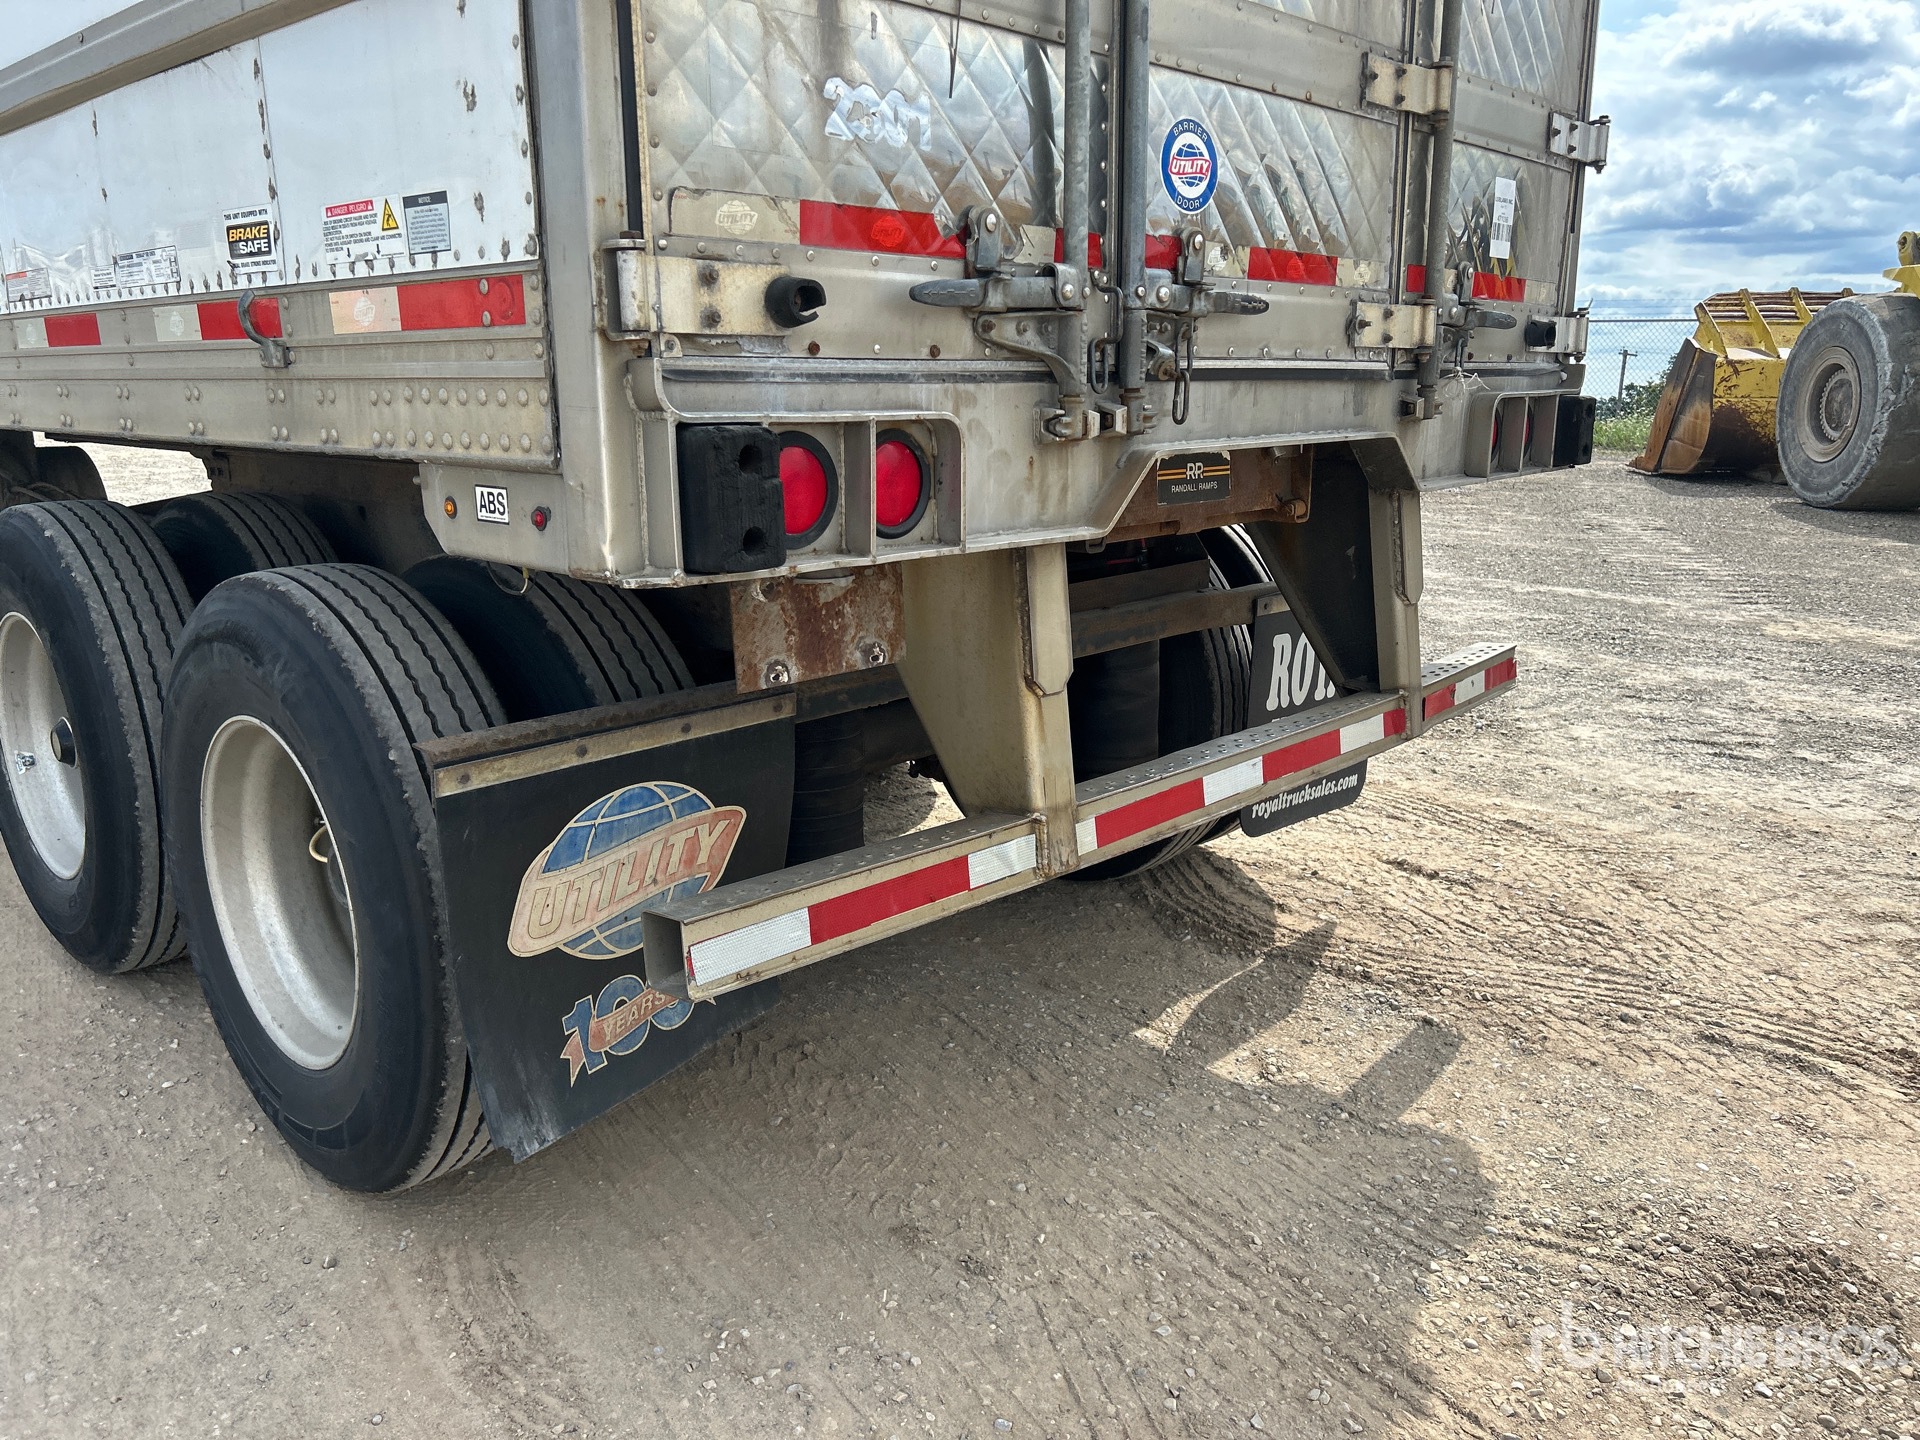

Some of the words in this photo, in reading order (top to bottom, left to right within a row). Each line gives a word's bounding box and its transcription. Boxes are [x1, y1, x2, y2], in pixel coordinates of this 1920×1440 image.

[1172, 121, 1208, 143] BARRIER
[1171, 158, 1210, 175] UTILITY
[331, 206, 348, 216] DANGER
[349, 203, 368, 212] PELIGRO
[1176, 195, 1201, 210] DOOR
[719, 211, 758, 226] UTILITY
[228, 224, 269, 242] BRAKE
[239, 238, 270, 254] SAFE
[1185, 461, 1205, 480] RR
[1171, 483, 1197, 494] RANDALL
[1198, 480, 1219, 491] RAMPS
[479, 490, 506, 517] ABS
[1251, 773, 1359, 819] royaltrucksales.com
[527, 818, 731, 940] UTILITY
[602, 990, 667, 1042] YEARS
